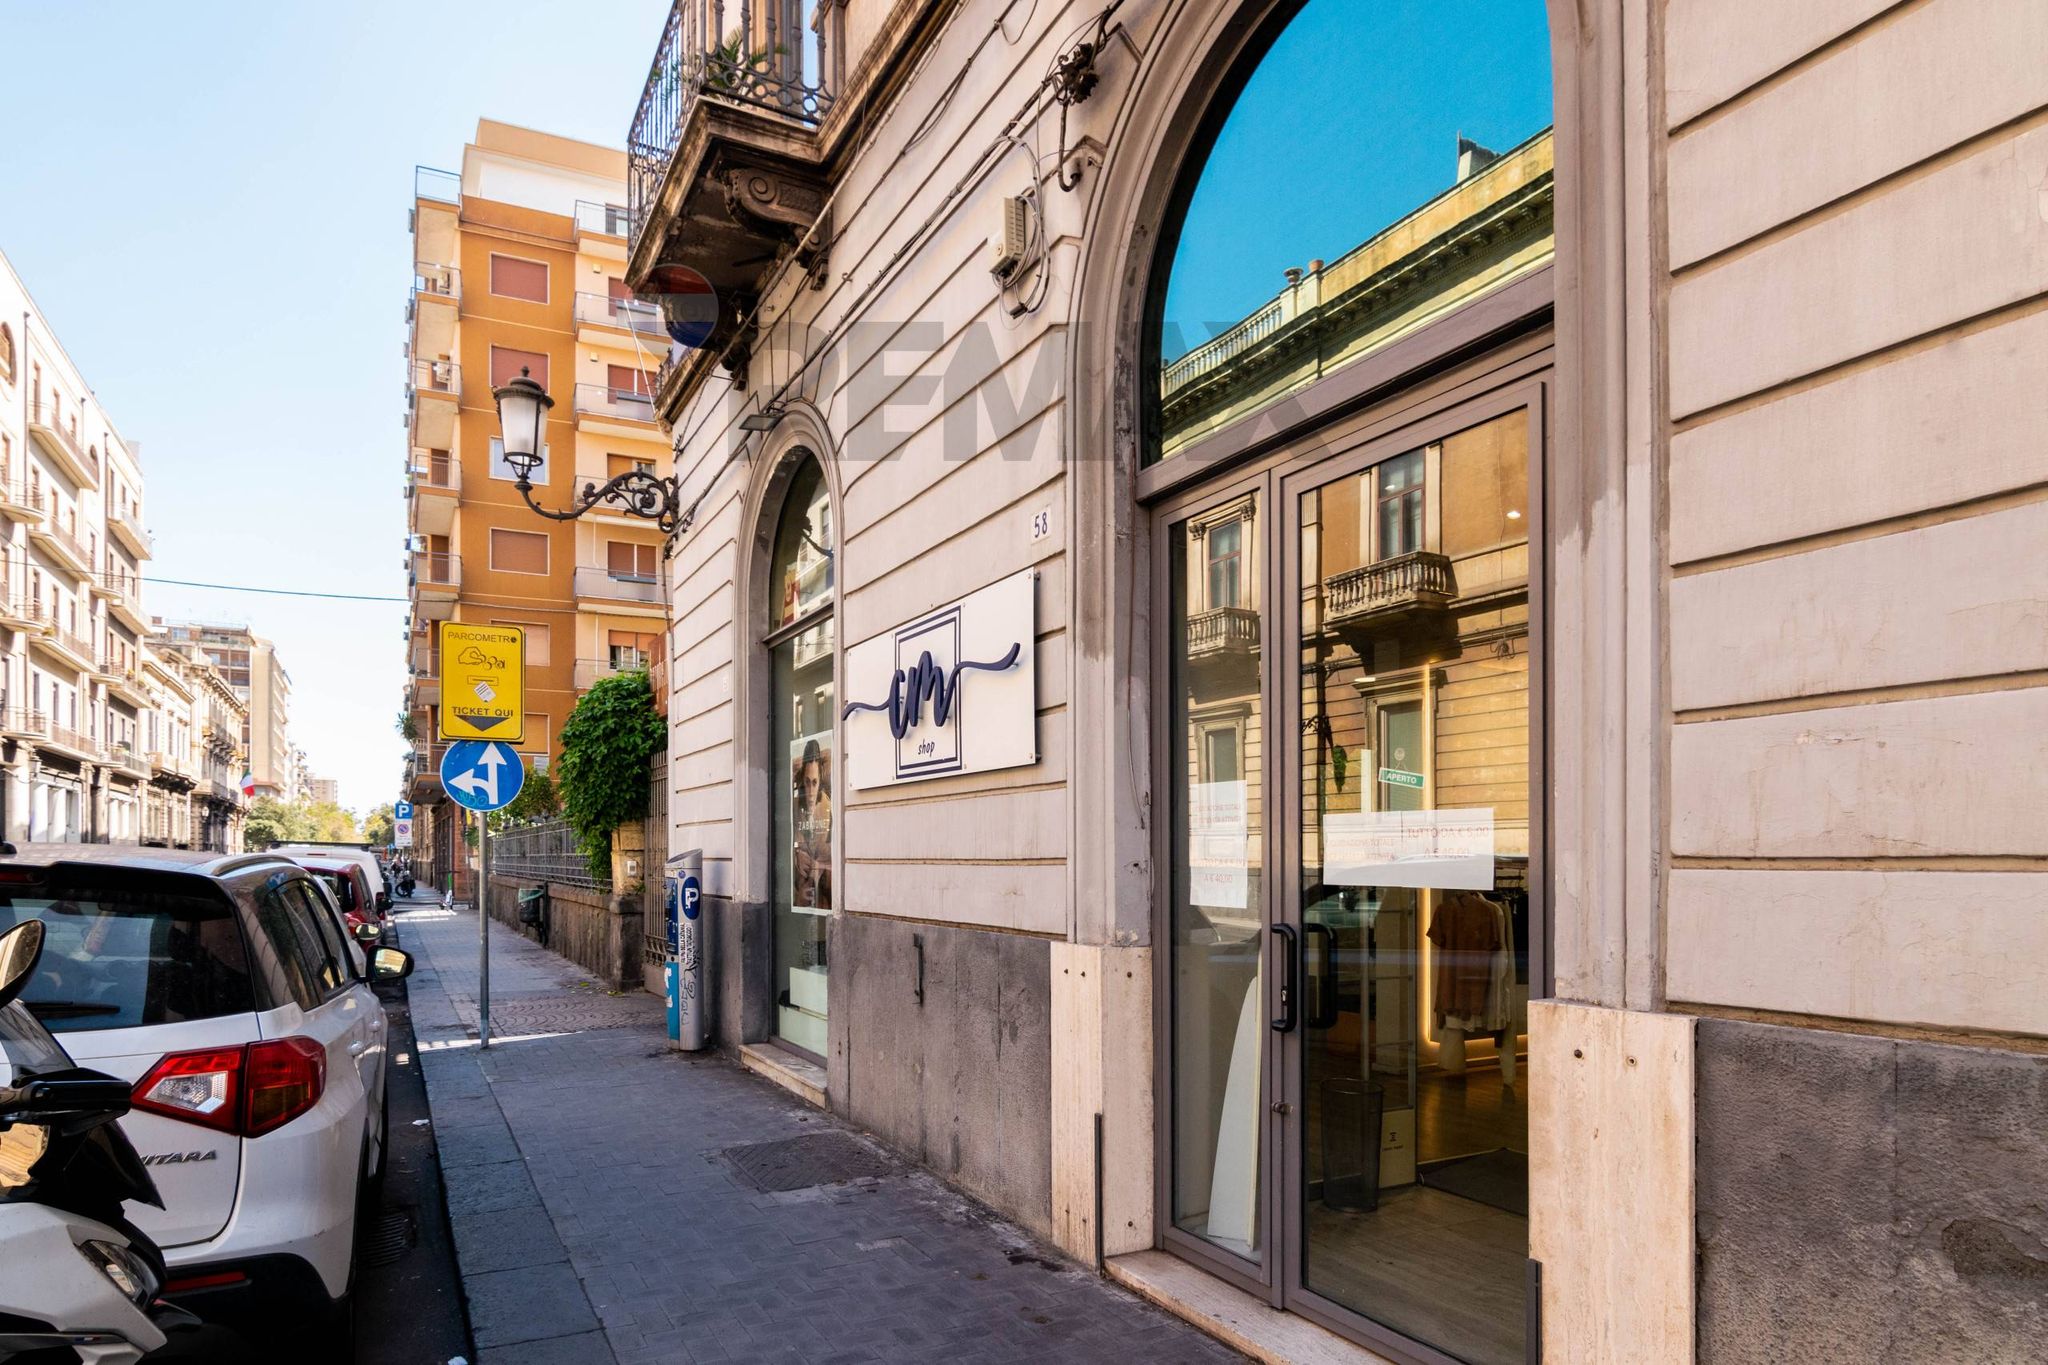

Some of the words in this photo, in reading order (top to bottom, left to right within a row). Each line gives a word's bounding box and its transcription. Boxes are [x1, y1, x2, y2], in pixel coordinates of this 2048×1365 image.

[1034, 511, 1048, 538] 58
[451, 706, 490, 716] TICKET
[494, 708, 514, 717] QUI
[917, 738, 935, 758] shop
[1385, 772, 1417, 784] APERTO
[398, 805, 409, 818] P
[685, 887, 699, 909] P
[141, 1149, 217, 1165] ITARA
